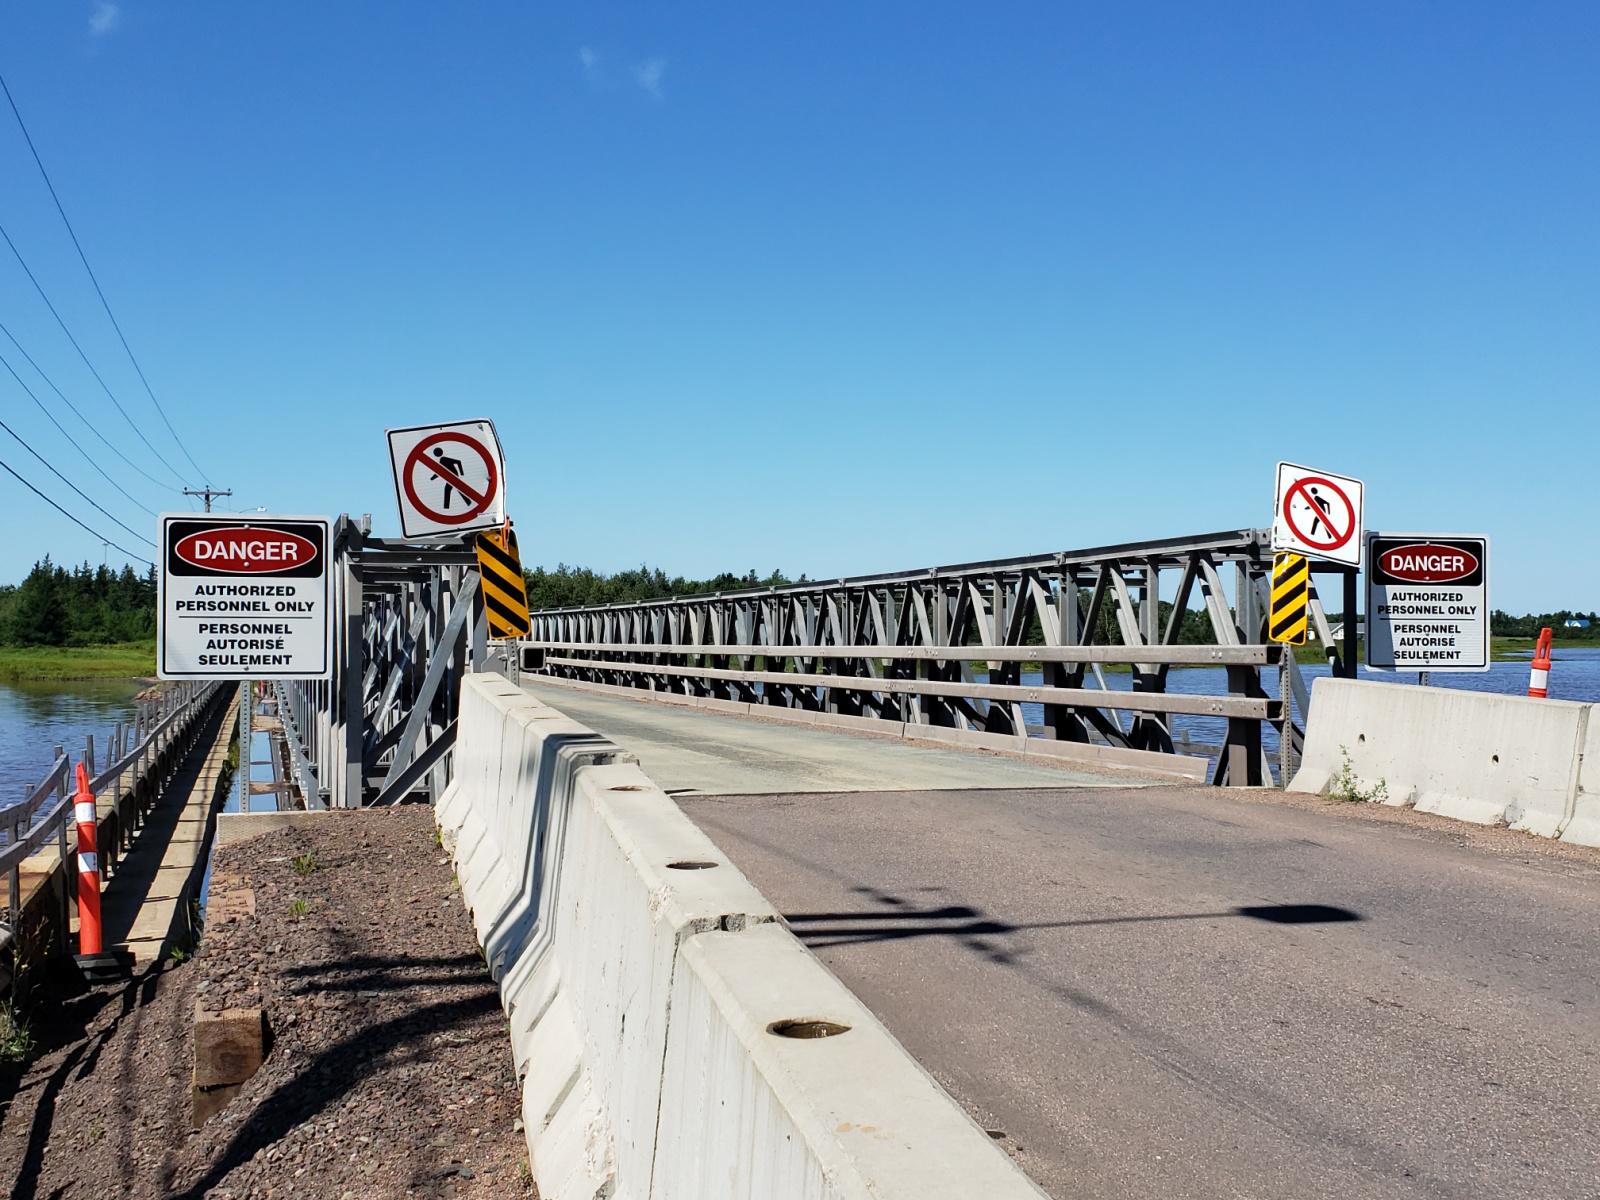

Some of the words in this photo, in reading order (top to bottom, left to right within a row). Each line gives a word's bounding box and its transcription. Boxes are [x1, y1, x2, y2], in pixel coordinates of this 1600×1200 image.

[195, 540, 298, 561] DANGER
[1390, 555, 1465, 572] DANGER
[195, 585, 296, 597] AUTHORIZED
[1391, 592, 1463, 602] AUTHORIZED
[175, 600, 271, 612] PERSONNEL
[274, 601, 315, 613] ONLY
[1377, 605, 1445, 615] PERSONNEL
[1447, 605, 1477, 615] ONLY
[198, 623, 293, 634] PERSONNEL
[1393, 624, 1462, 634] PERSONNEL
[206, 636, 285, 650] AUTORISÉ
[1399, 635, 1455, 647] AUTORISÉ
[198, 654, 293, 666] SEULEMENT
[1393, 650, 1462, 660] SEULEMENT
